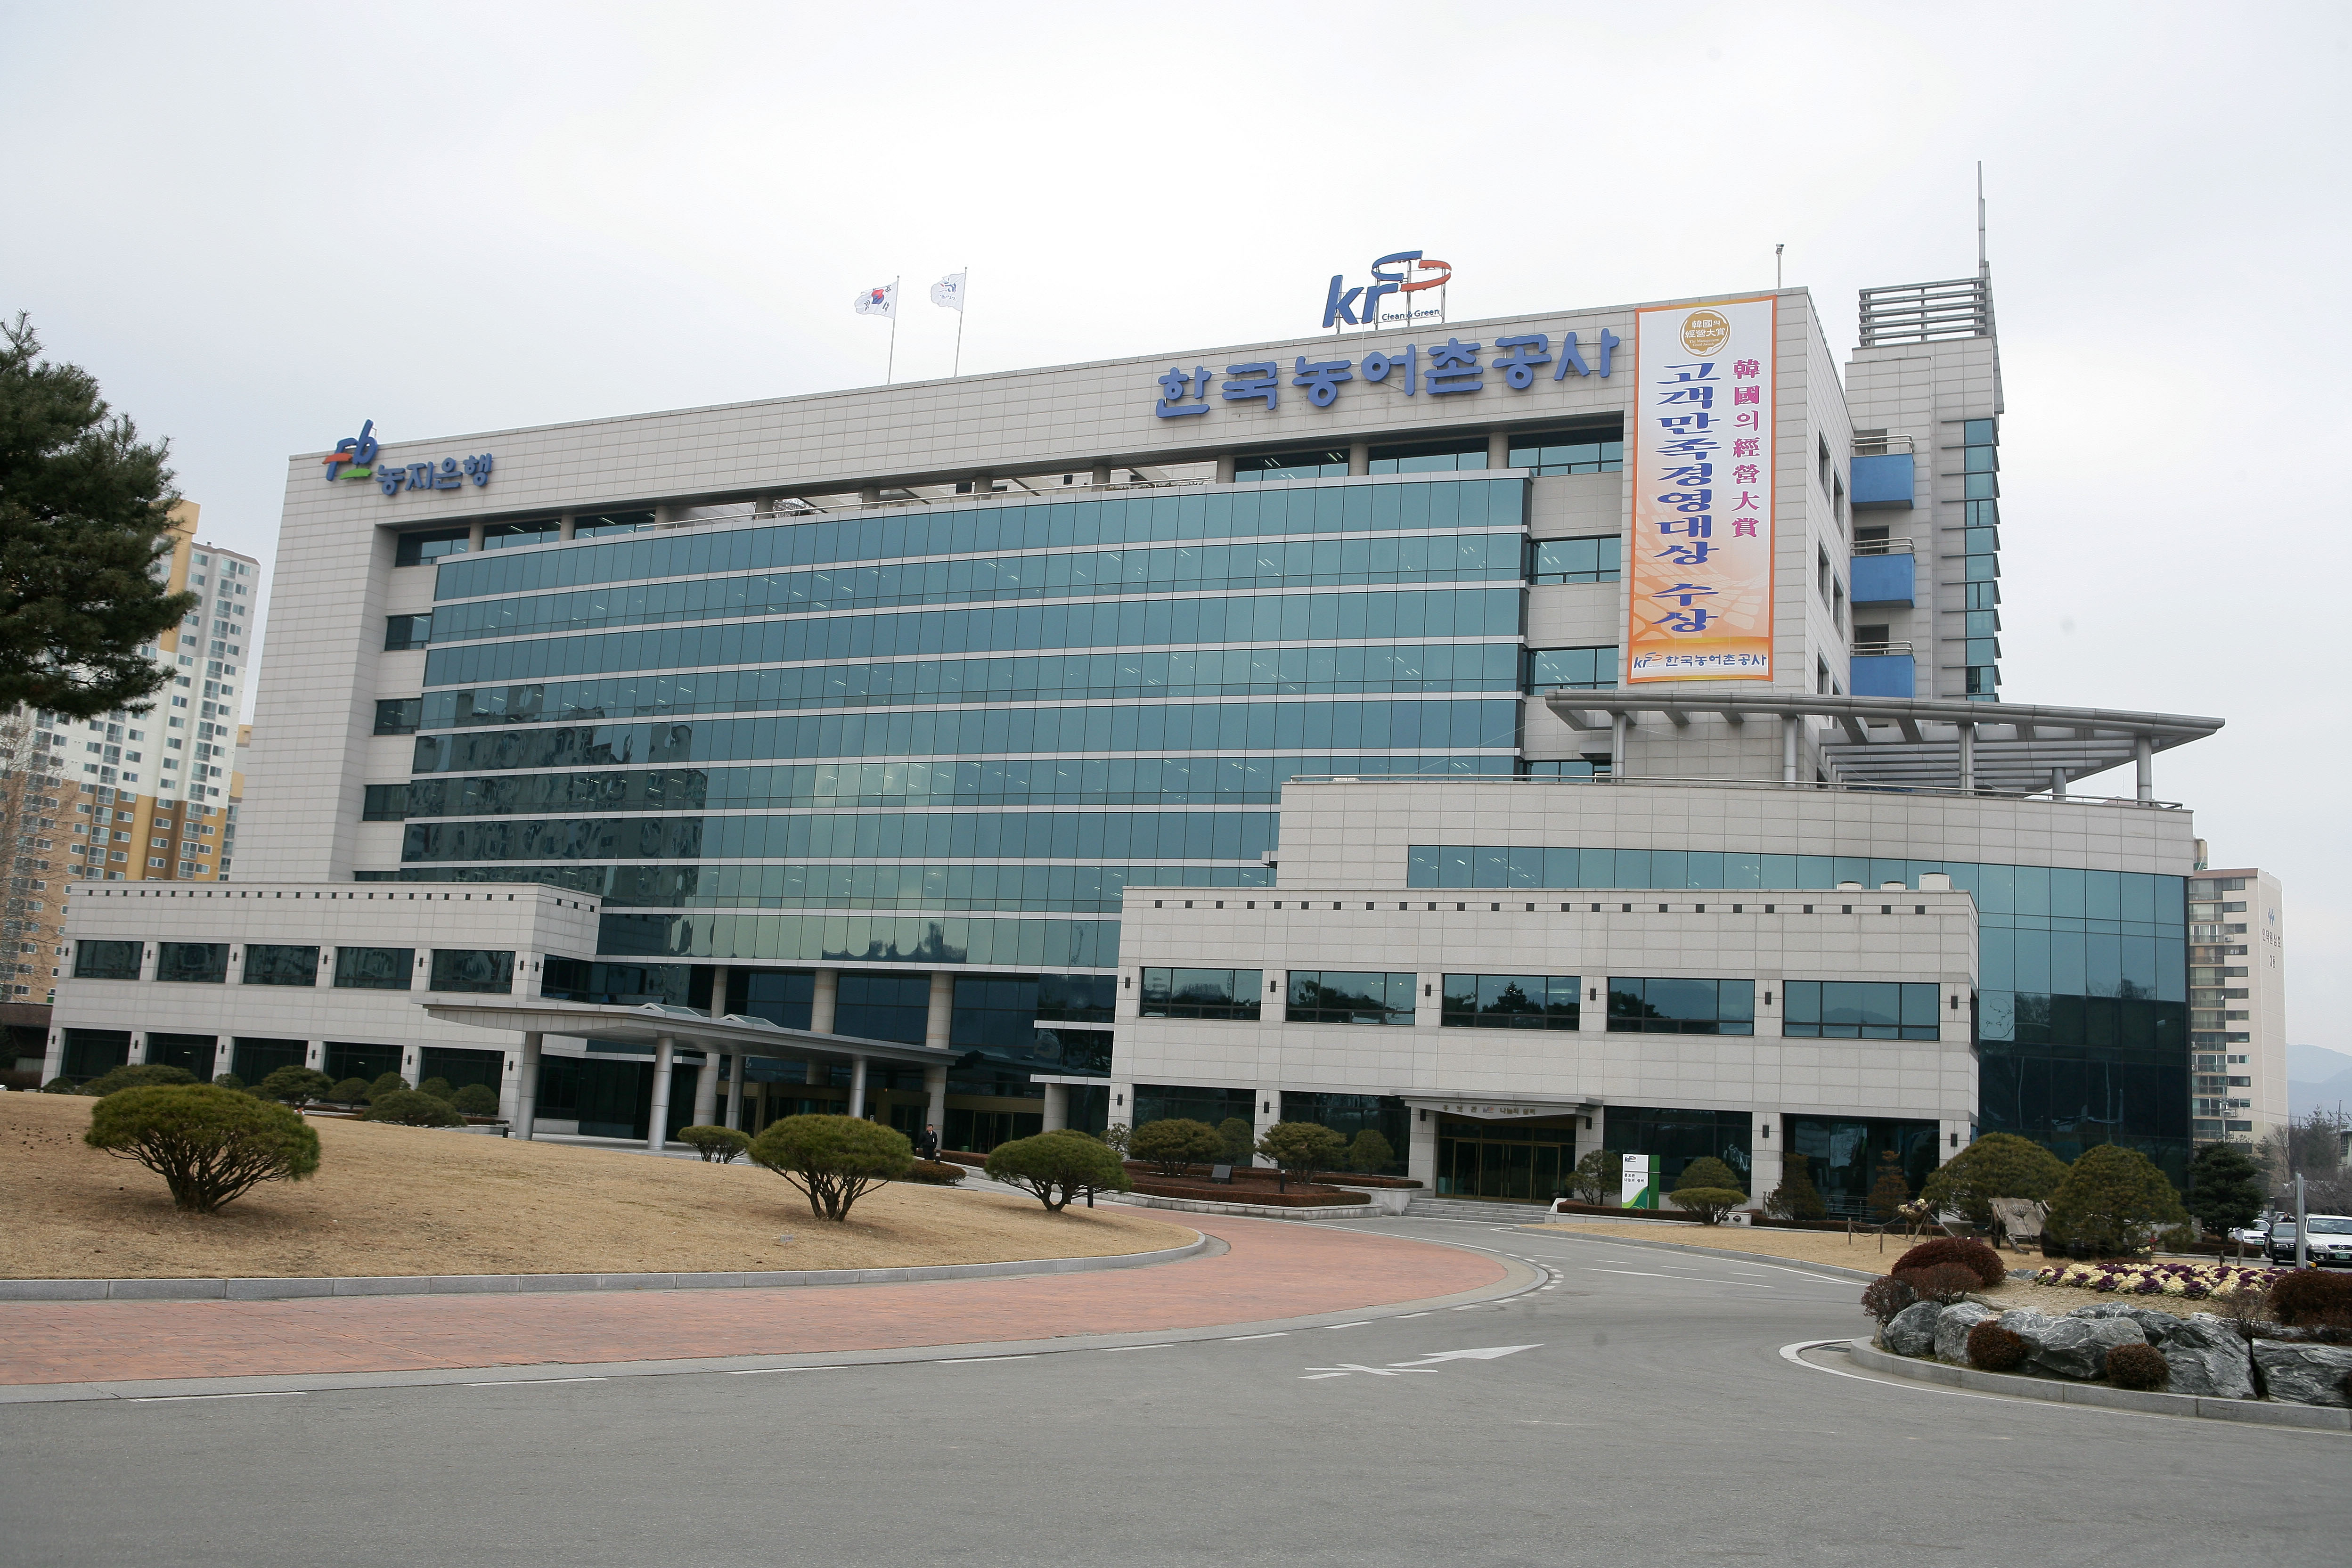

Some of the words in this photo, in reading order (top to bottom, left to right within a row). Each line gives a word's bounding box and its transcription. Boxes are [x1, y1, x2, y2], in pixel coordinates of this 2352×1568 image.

[1382, 313, 1406, 321] Clean
[1414, 309, 1440, 317] Green
[1155, 328, 1620, 418] 한국농어촌공사
[376, 453, 492, 495] 농지은행
[1653, 362, 1722, 565] 고객만족경영대상
[1652, 583, 1719, 632] 수상
[1666, 654, 1767, 667] 한국농어촌공사
